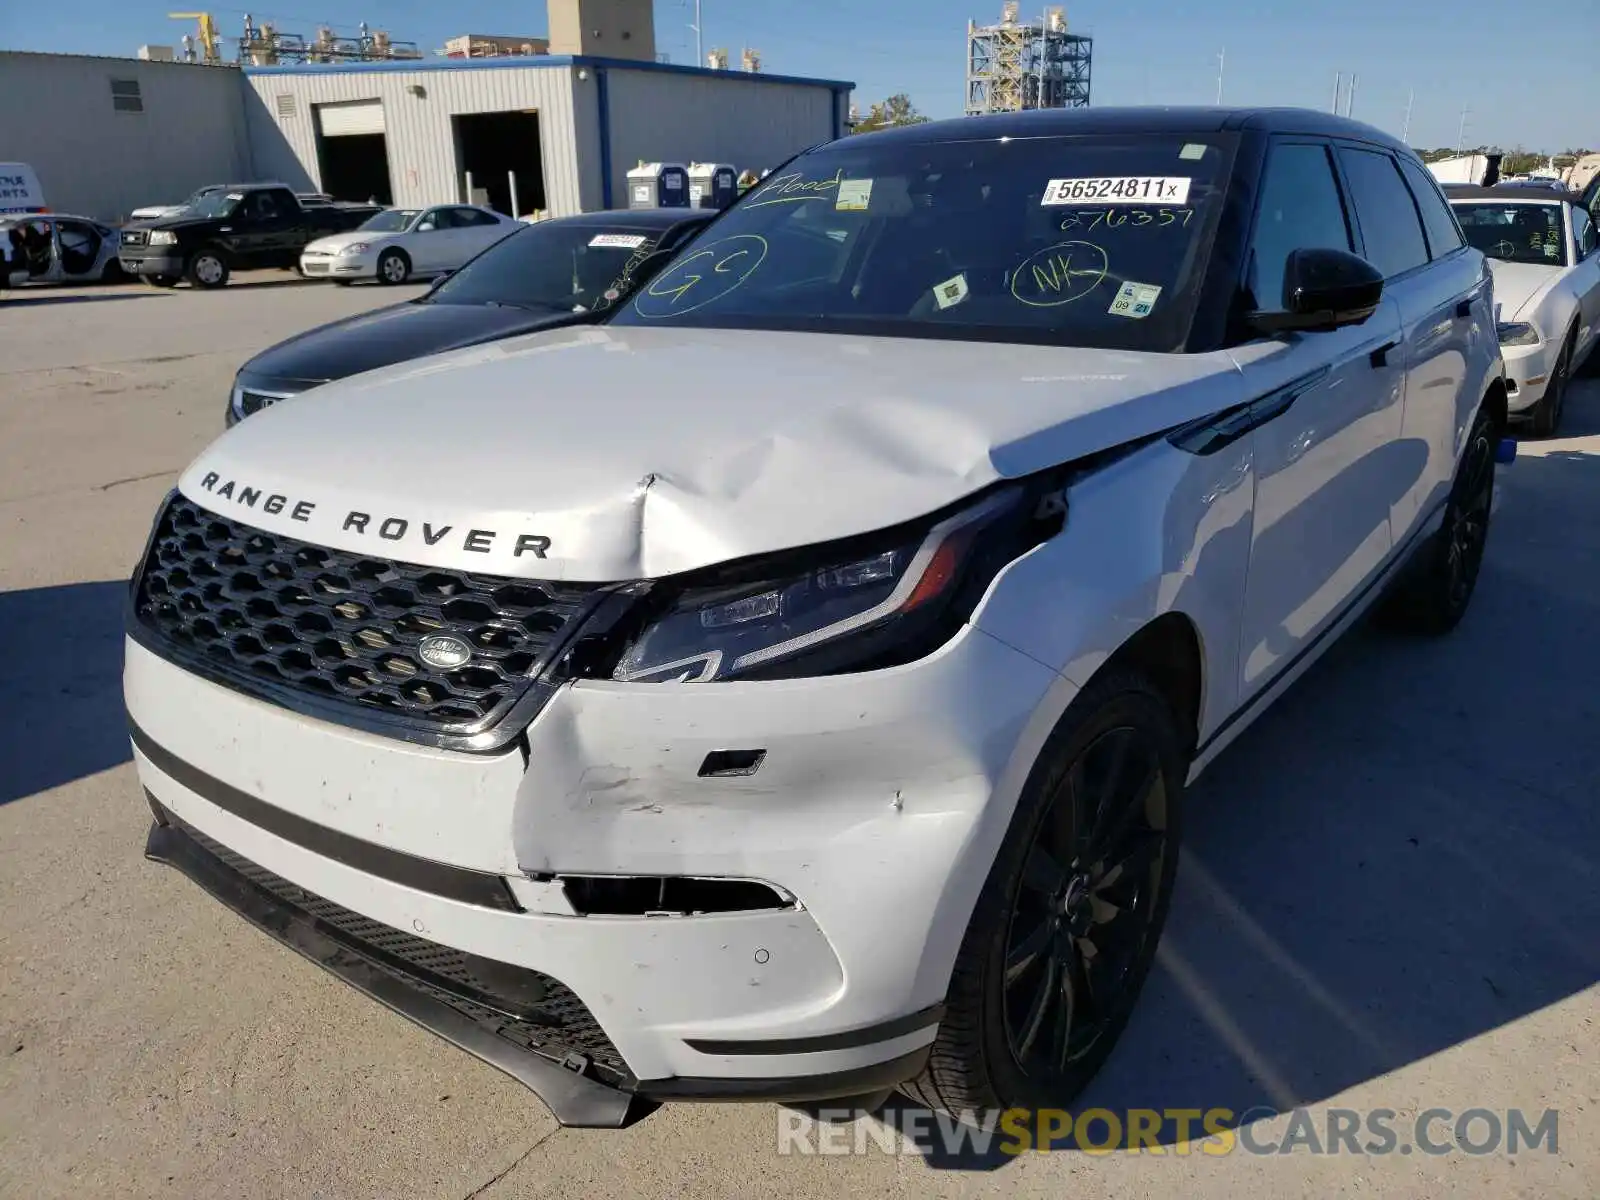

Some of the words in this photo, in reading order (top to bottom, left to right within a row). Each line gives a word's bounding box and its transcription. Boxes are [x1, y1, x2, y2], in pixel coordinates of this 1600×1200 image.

[1057, 178, 1166, 198] 56524811
[1115, 300, 1129, 311] 09
[200, 471, 316, 523] RANGE
[342, 511, 552, 560] ROVER
